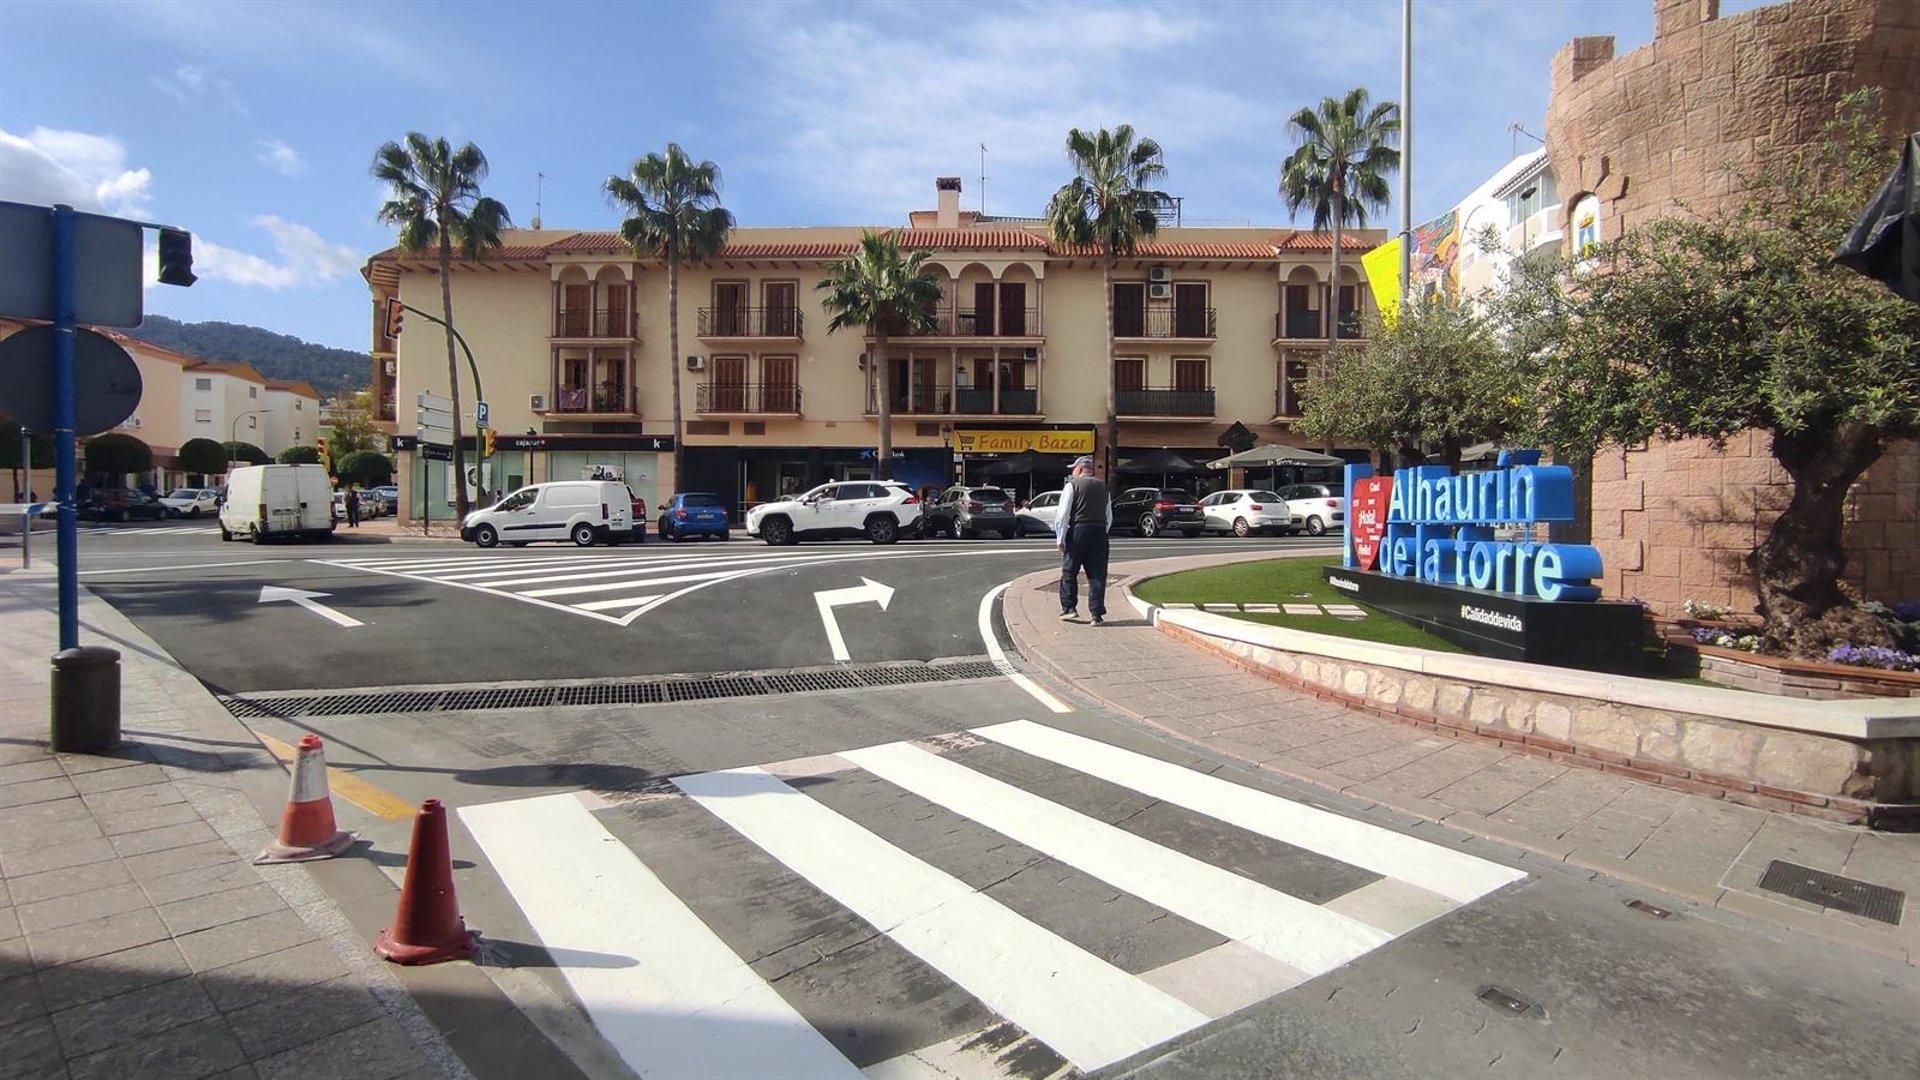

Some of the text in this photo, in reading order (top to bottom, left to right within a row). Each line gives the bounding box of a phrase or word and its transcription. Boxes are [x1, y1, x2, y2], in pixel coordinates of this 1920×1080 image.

[479, 404, 487, 419] P
[979, 434, 1088, 449] Family Bazar
[1379, 523, 1563, 601] de la torre
[1460, 605, 1523, 632] #Calidaddevida
